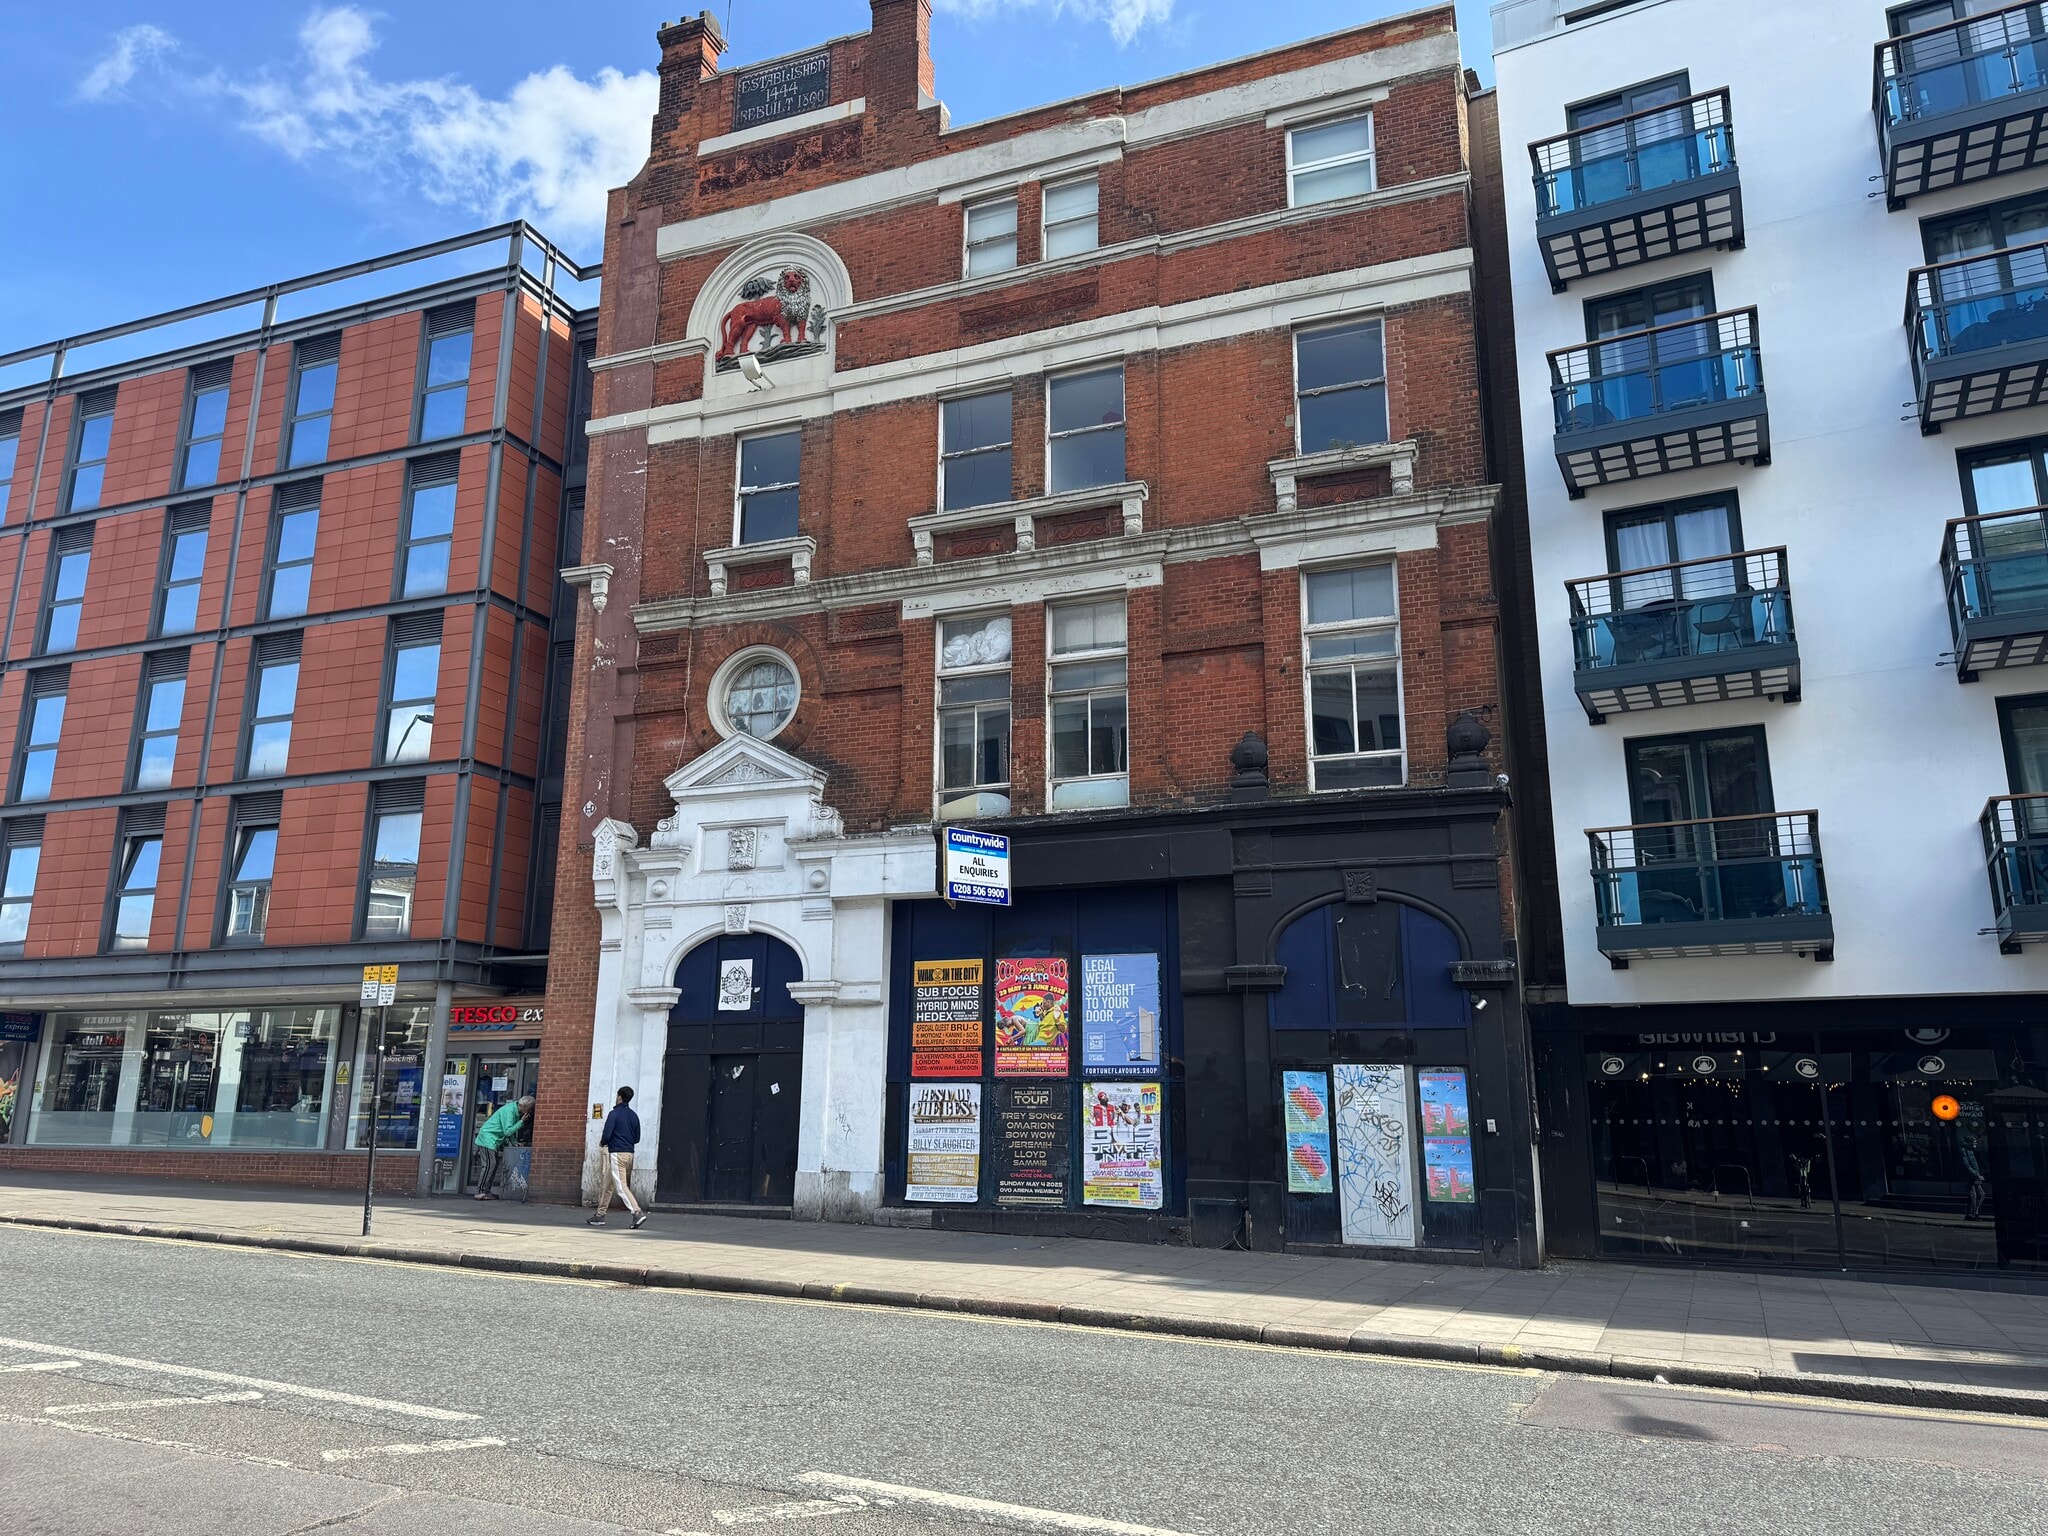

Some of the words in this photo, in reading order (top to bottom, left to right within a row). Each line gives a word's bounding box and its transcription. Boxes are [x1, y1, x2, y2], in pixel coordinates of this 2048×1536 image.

[742, 59, 826, 94] ESTABLISHED
[766, 82, 798, 102] 1444
[740, 97, 794, 122] REBUILT
[952, 832, 1004, 849] countrywide
[973, 857, 985, 866] ALL
[960, 865, 998, 878] ENQUIRIES
[953, 884, 971, 895] 0208
[972, 886, 986, 896] 506
[988, 888, 1004, 898] 9900
[1085, 959, 1117, 972] LEGAL
[951, 967, 962, 980] THE
[1015, 972, 1049, 983] MALTA
[1085, 972, 1114, 984] WEED
[917, 987, 939, 997] SUB
[942, 986, 979, 996] FOCUS
[1008, 985, 1021, 993] MAY
[1085, 984, 1136, 996] STRAIGHT
[917, 1001, 948, 1011] HYBRID
[951, 1000, 979, 1010] MINDS
[1086, 997, 1098, 1009] TO
[1102, 997, 1129, 1009] YOUR
[450, 1006, 517, 1023] TESCO
[917, 1012, 953, 1021] HEDEX
[1086, 1010, 1114, 1022] DOOR
[916, 1024, 934, 1032] SPECIAL
[951, 1023, 979, 1031] BRU-C
[1014, 1096, 1049, 1104] TOUR
[1142, 1092, 1157, 1106] 06
[913, 1139, 933, 1149] BILLY
[934, 1139, 975, 1149] SLAUGHTER
[1091, 1142, 1154, 1153] DRIVERS
